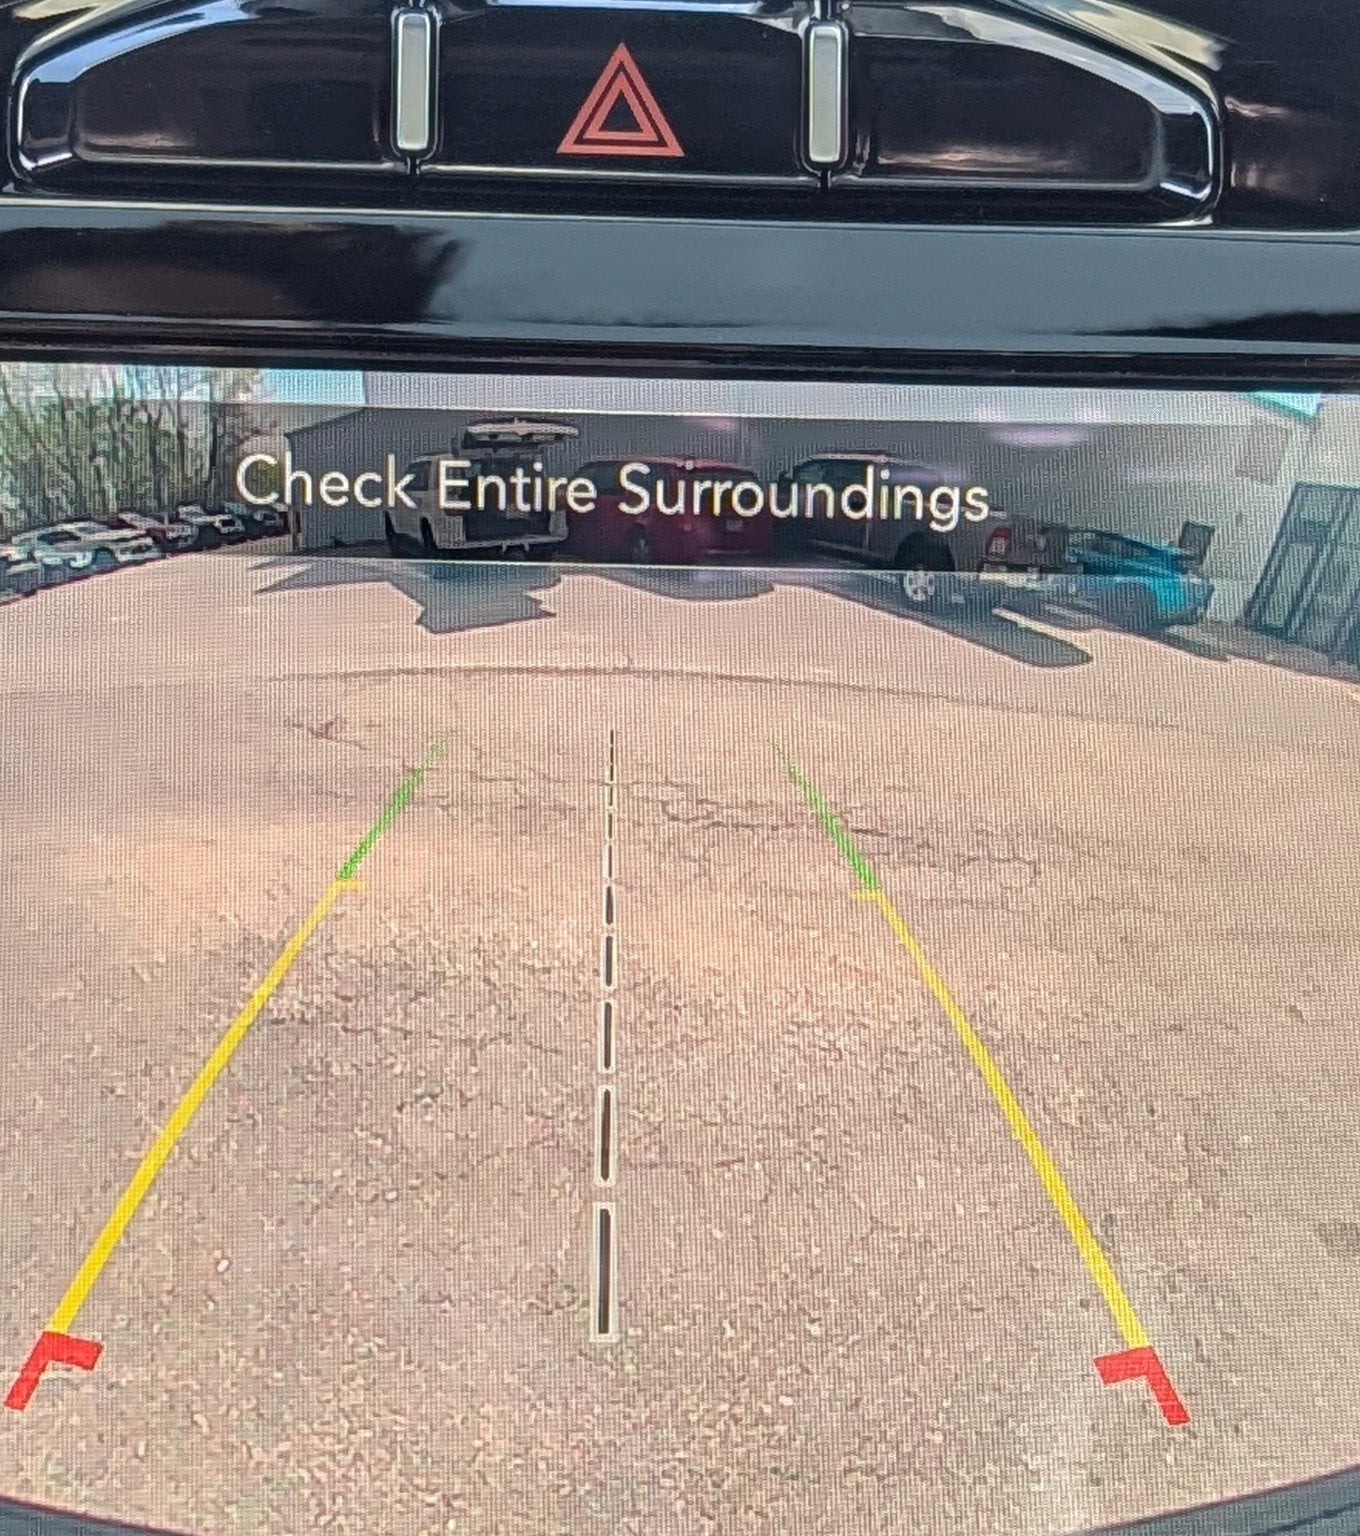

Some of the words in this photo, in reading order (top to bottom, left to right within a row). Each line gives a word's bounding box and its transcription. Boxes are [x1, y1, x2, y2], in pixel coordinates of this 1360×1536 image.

[237, 453, 417, 508] Check
[439, 460, 597, 513] Entire
[617, 464, 991, 532] Surroundings
